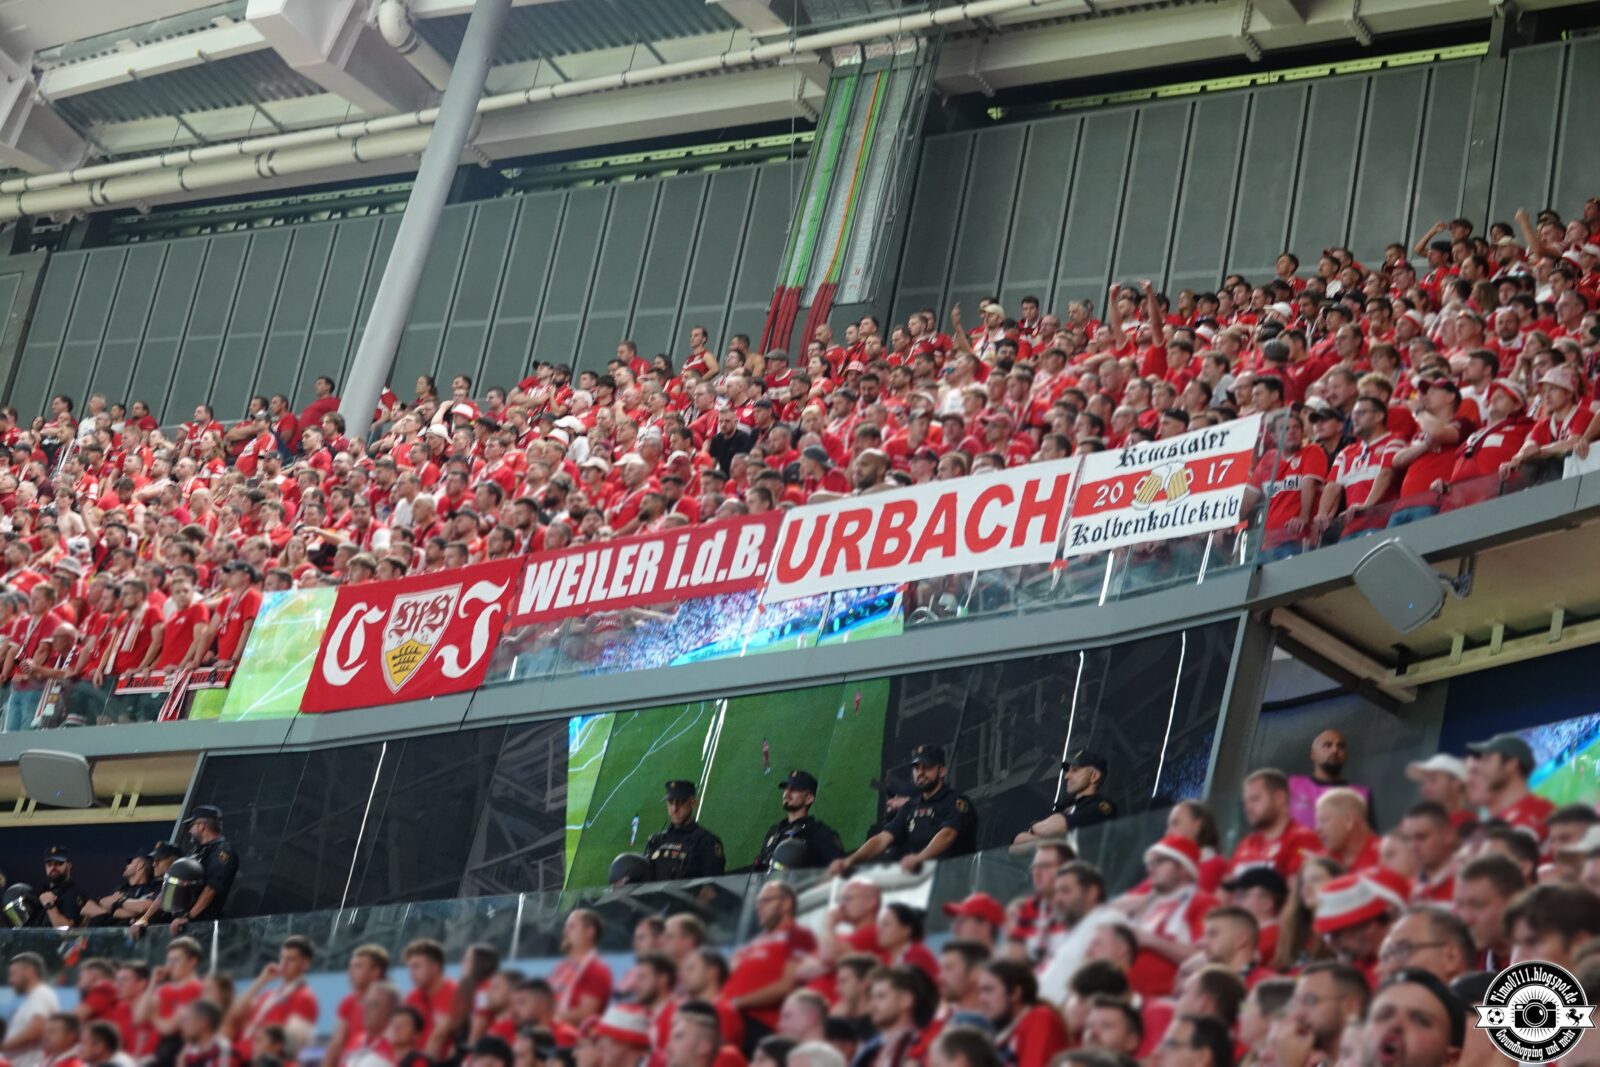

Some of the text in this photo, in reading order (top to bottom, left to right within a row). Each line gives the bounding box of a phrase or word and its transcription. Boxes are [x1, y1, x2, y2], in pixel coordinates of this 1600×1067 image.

[1092, 481, 1124, 508] 20
[1207, 458, 1235, 485] 17
[776, 473, 1071, 584] URBACH
[1070, 495, 1240, 549] Kolbenkollektiv
[517, 524, 767, 615] WEILER i.d.B.
